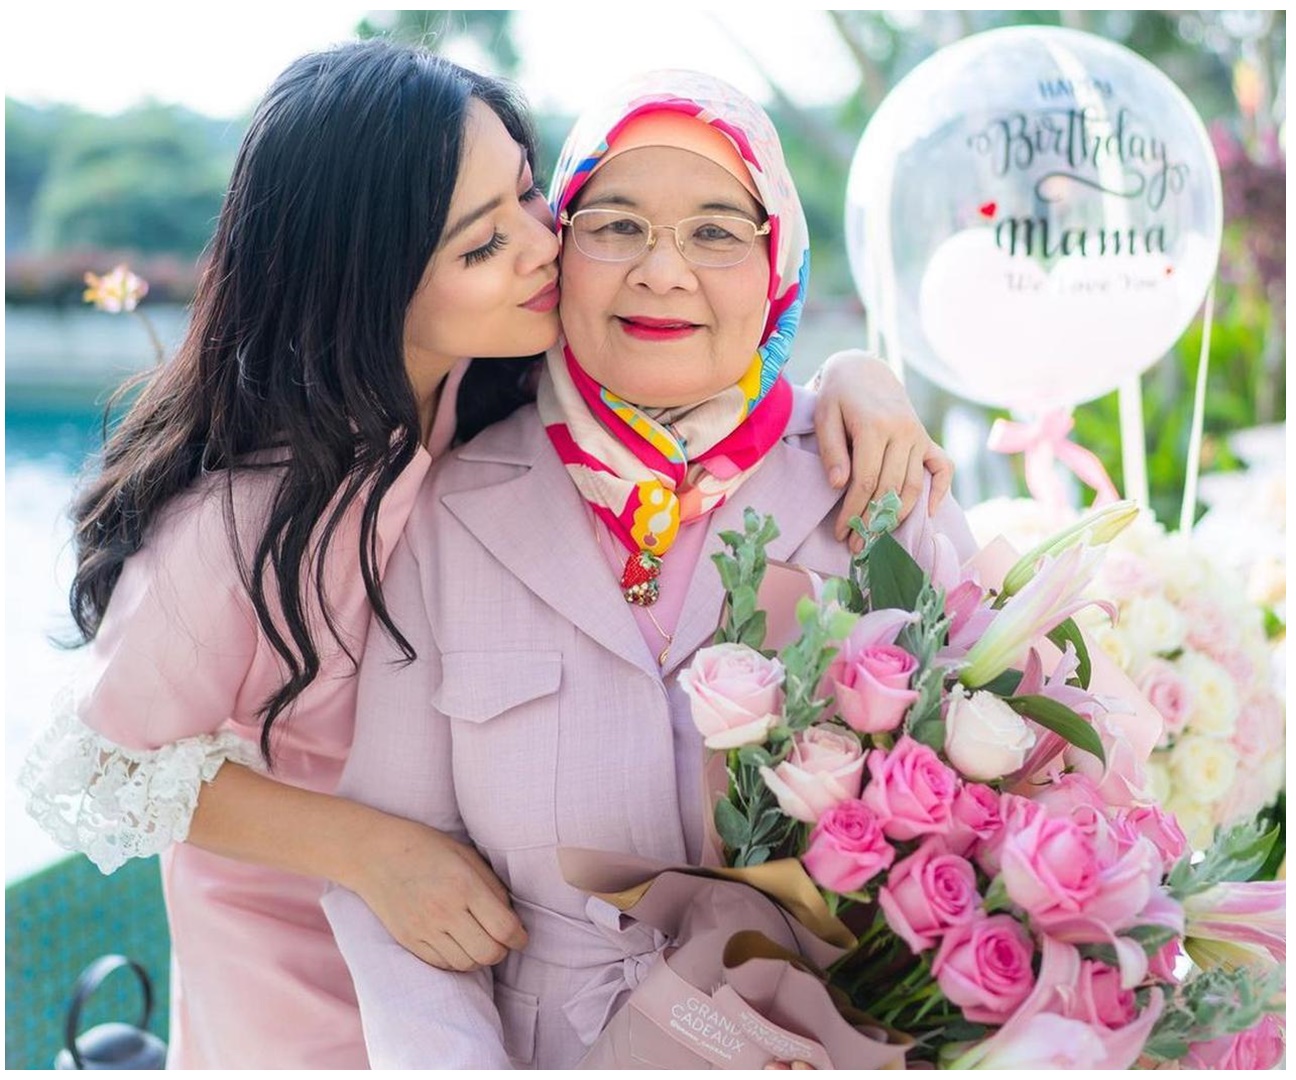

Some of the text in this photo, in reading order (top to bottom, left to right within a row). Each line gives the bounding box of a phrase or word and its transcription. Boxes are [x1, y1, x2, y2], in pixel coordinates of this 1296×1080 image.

[967, 107, 1189, 211] Birthday
[996, 216, 1167, 259] Mama
[671, 1004, 746, 1054] CADEAUX
[686, 997, 744, 1035] GRAND
